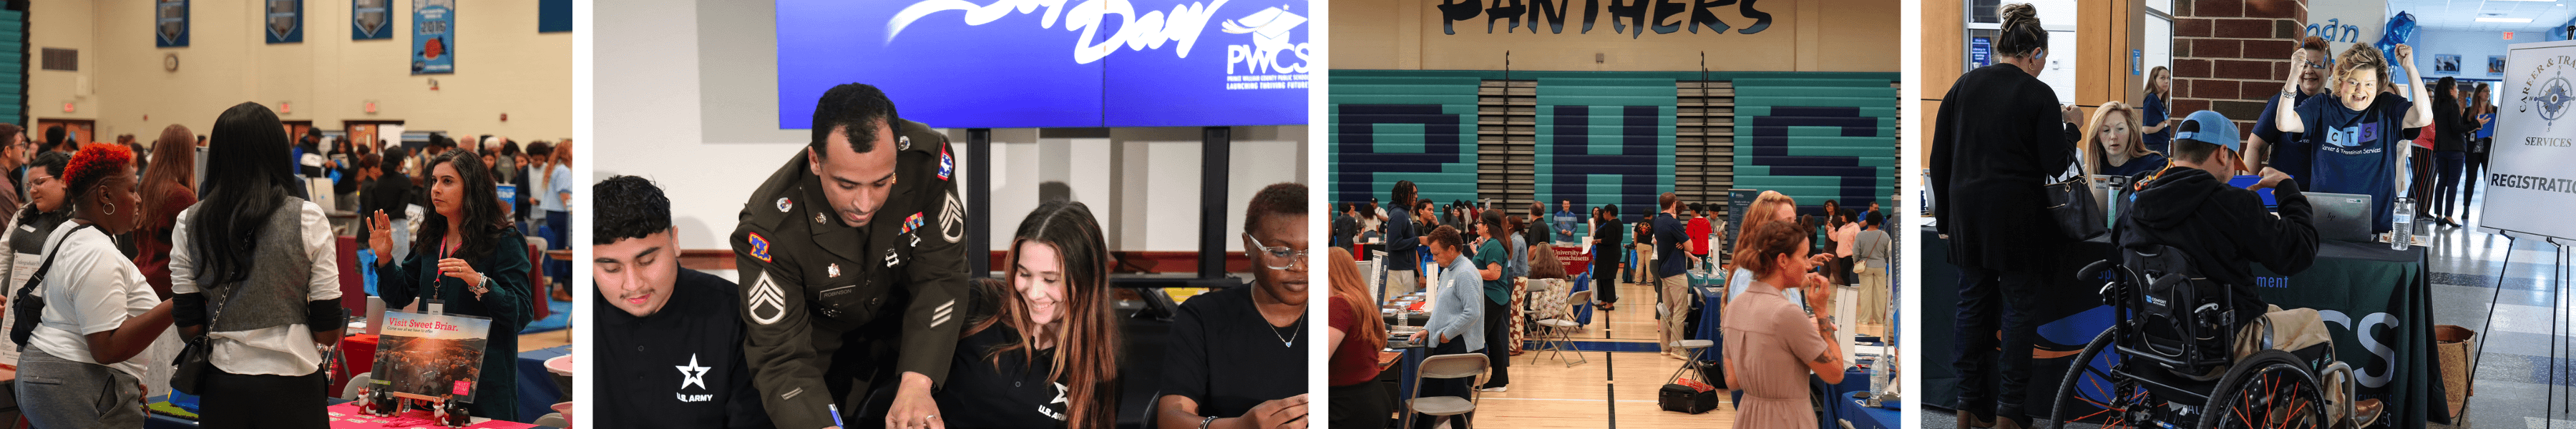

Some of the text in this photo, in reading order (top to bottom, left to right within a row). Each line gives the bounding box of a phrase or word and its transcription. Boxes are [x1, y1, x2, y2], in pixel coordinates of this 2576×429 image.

[1065, 0, 1231, 64] Day
[1227, 42, 1309, 74] PWCS
[2519, 64, 2545, 113] CAREER
[2547, 58, 2555, 67] &
[2524, 137, 2572, 147] SERVICES
[2327, 212, 2336, 221] hp
[823, 289, 852, 298] ROBINSON
[389, 317, 458, 331] Visit Sweet Briar.
[676, 392, 713, 403] U.S. ARMY
[1038, 404, 1067, 422] U.S. ARM
